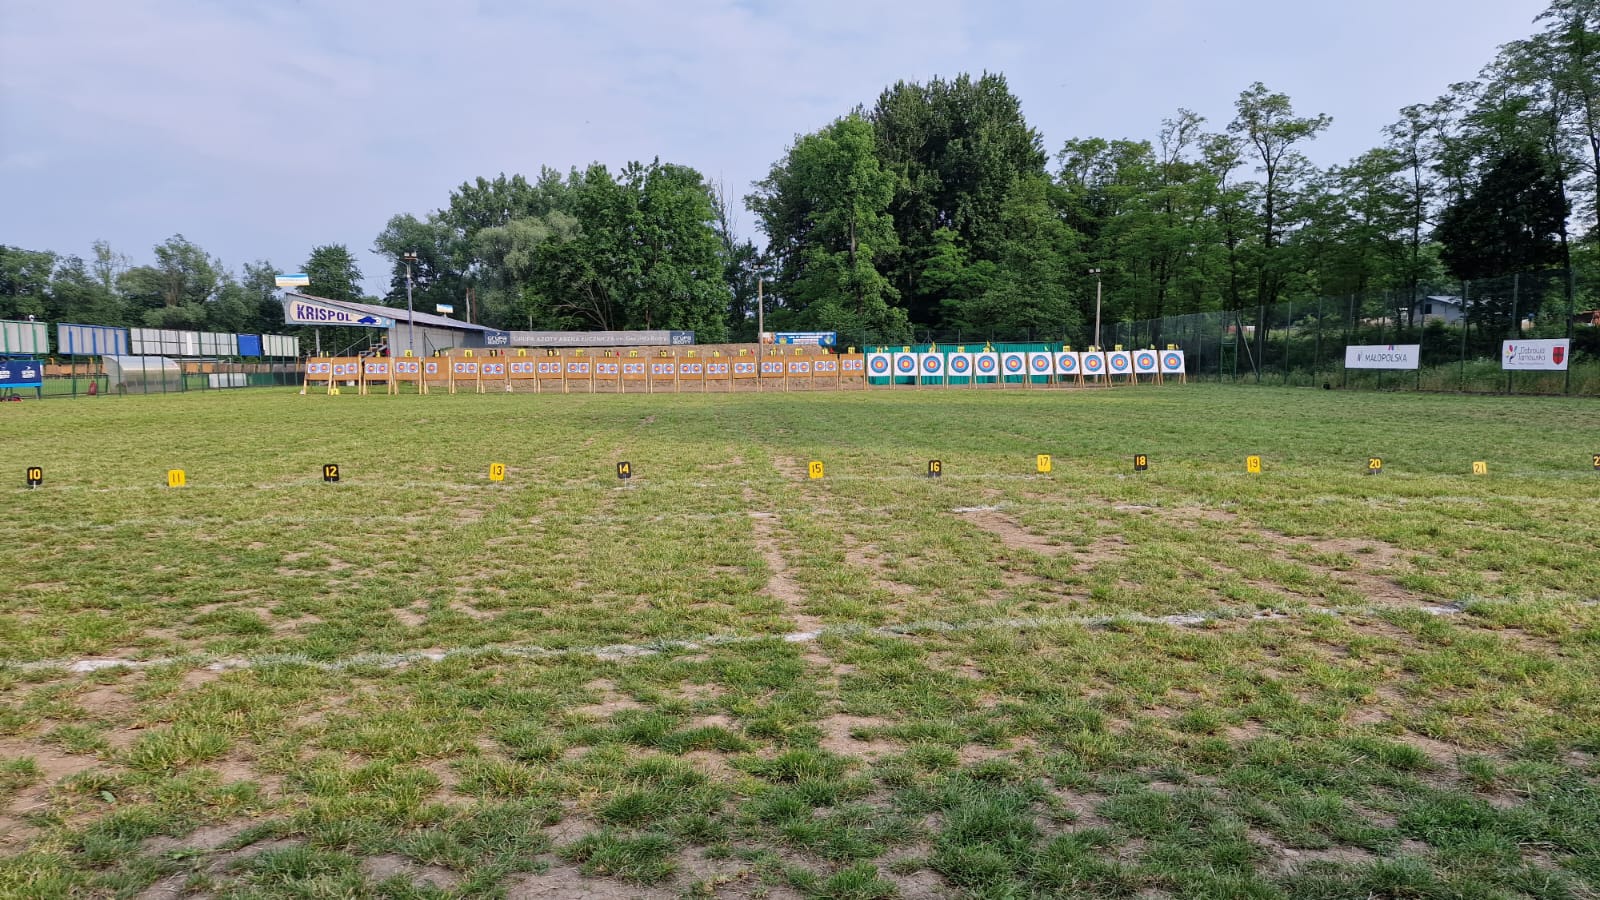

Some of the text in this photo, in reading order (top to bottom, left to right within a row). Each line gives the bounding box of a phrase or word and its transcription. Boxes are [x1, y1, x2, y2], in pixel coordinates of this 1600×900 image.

[297, 304, 352, 322] KRISPOL
[1040, 456, 1048, 466] 17
[1136, 455, 1145, 466] 18
[1250, 458, 1258, 468] 19
[1369, 458, 1381, 469] 20
[1593, 456, 1600, 466] 2
[326, 466, 337, 477] 12
[492, 464, 502, 476] 13
[619, 463, 629, 474] 14
[812, 463, 821, 474] 15
[930, 461, 940, 472] 16
[1475, 463, 1484, 473] 21
[29, 469, 41, 480] 10
[171, 471, 181, 483] 11
